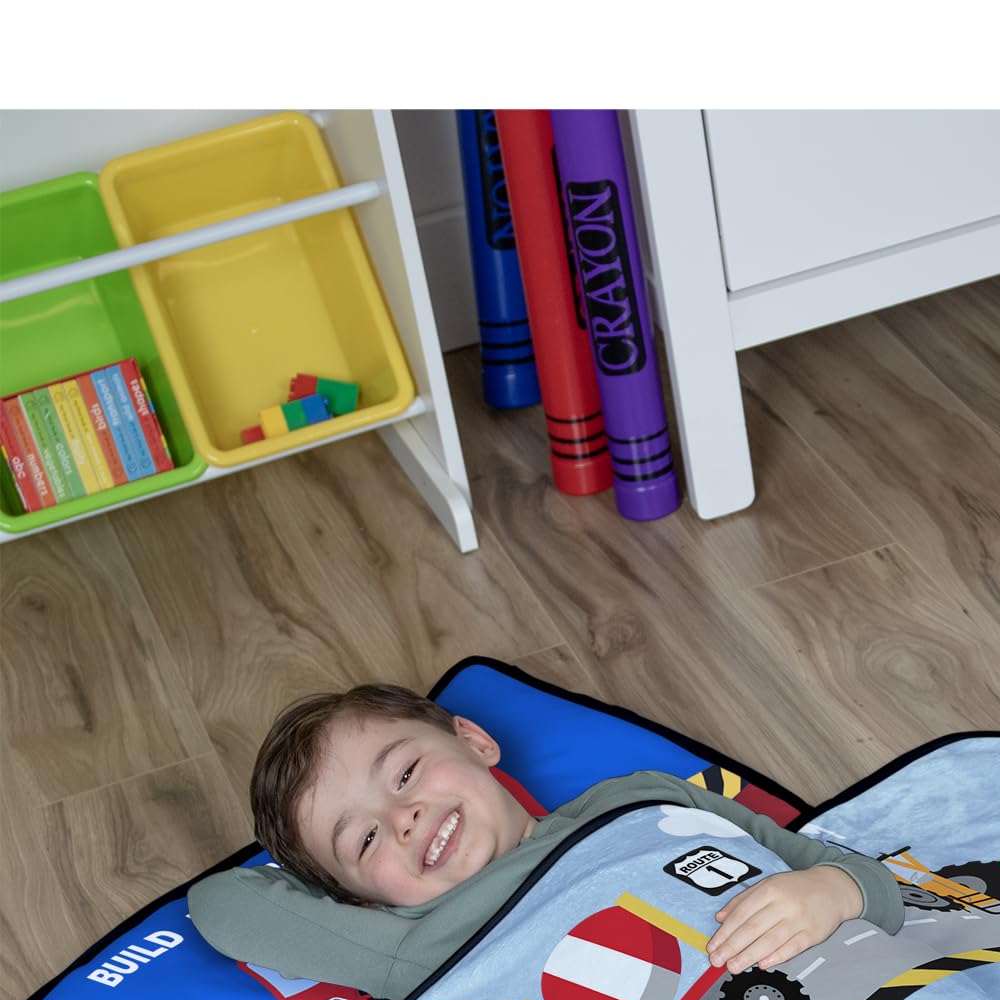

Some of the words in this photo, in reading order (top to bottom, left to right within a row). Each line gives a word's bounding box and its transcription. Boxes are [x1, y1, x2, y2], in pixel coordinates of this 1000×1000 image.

[568, 187, 640, 371] CRAYON
[130, 378, 150, 417] shapes
[91, 403, 107, 431] birds
[12, 456, 26, 479] abc
[27, 453, 49, 497] numbers
[55, 443, 73, 475] colors
[679, 851, 720, 874] ROUTE
[705, 864, 735, 880] 1
[86, 929, 185, 988] BUILD
